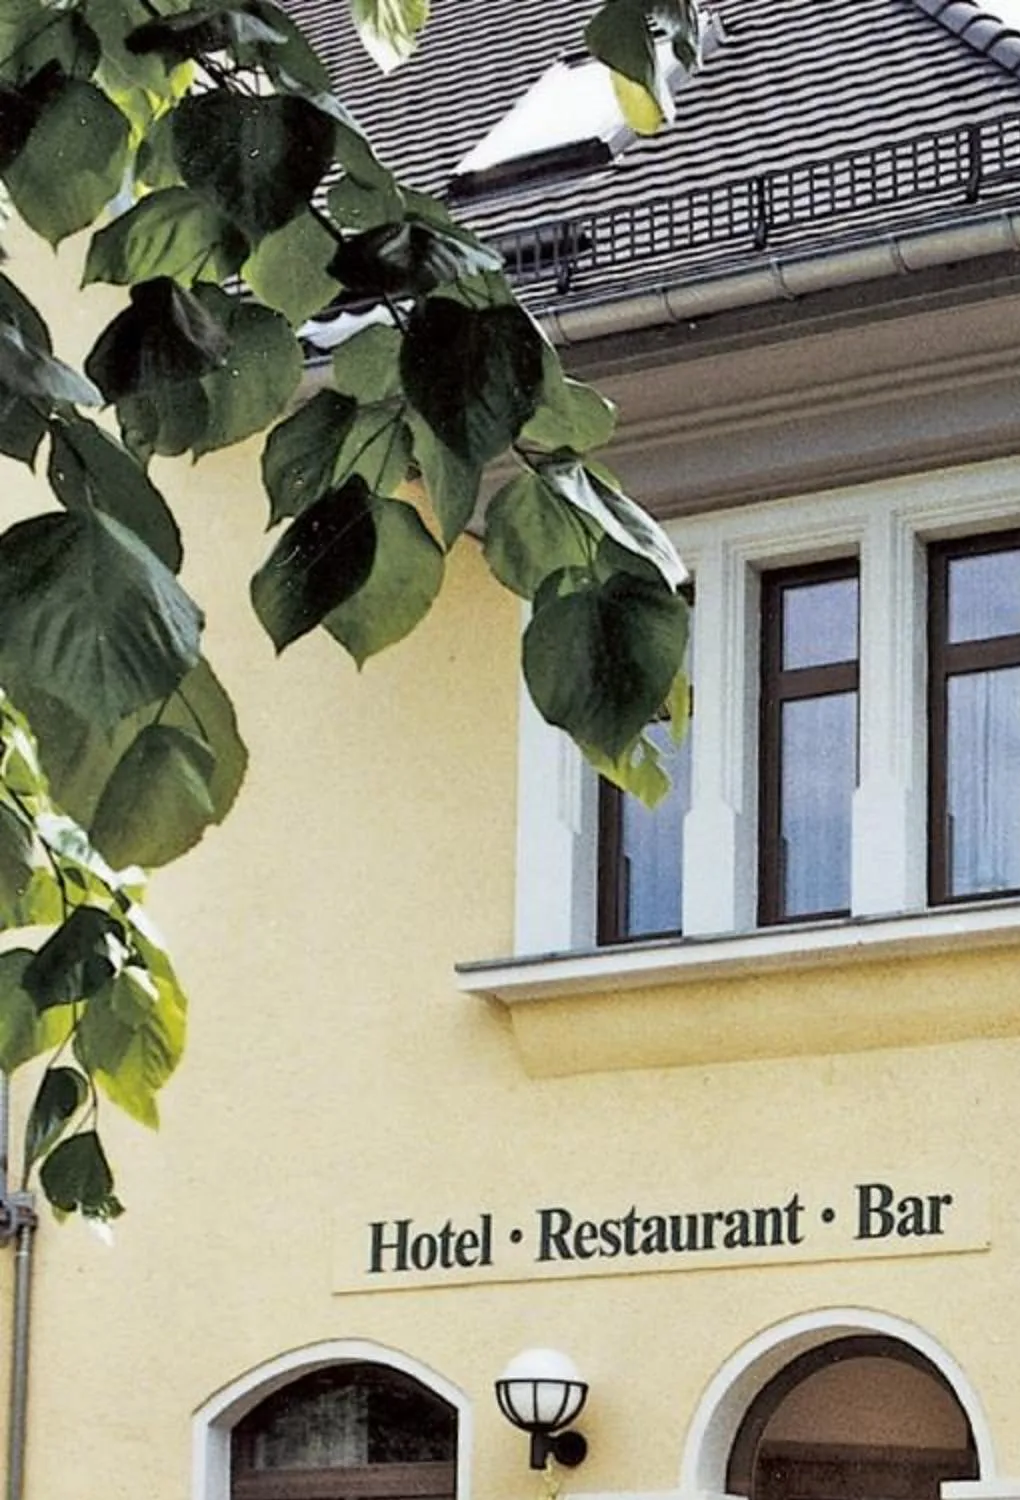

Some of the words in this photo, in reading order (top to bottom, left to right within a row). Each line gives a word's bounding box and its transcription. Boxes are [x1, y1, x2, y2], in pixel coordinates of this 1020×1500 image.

[367, 1213, 493, 1273] Hotel
[535, 1193, 804, 1262] Restaurant
[853, 1183, 953, 1239] Bar
